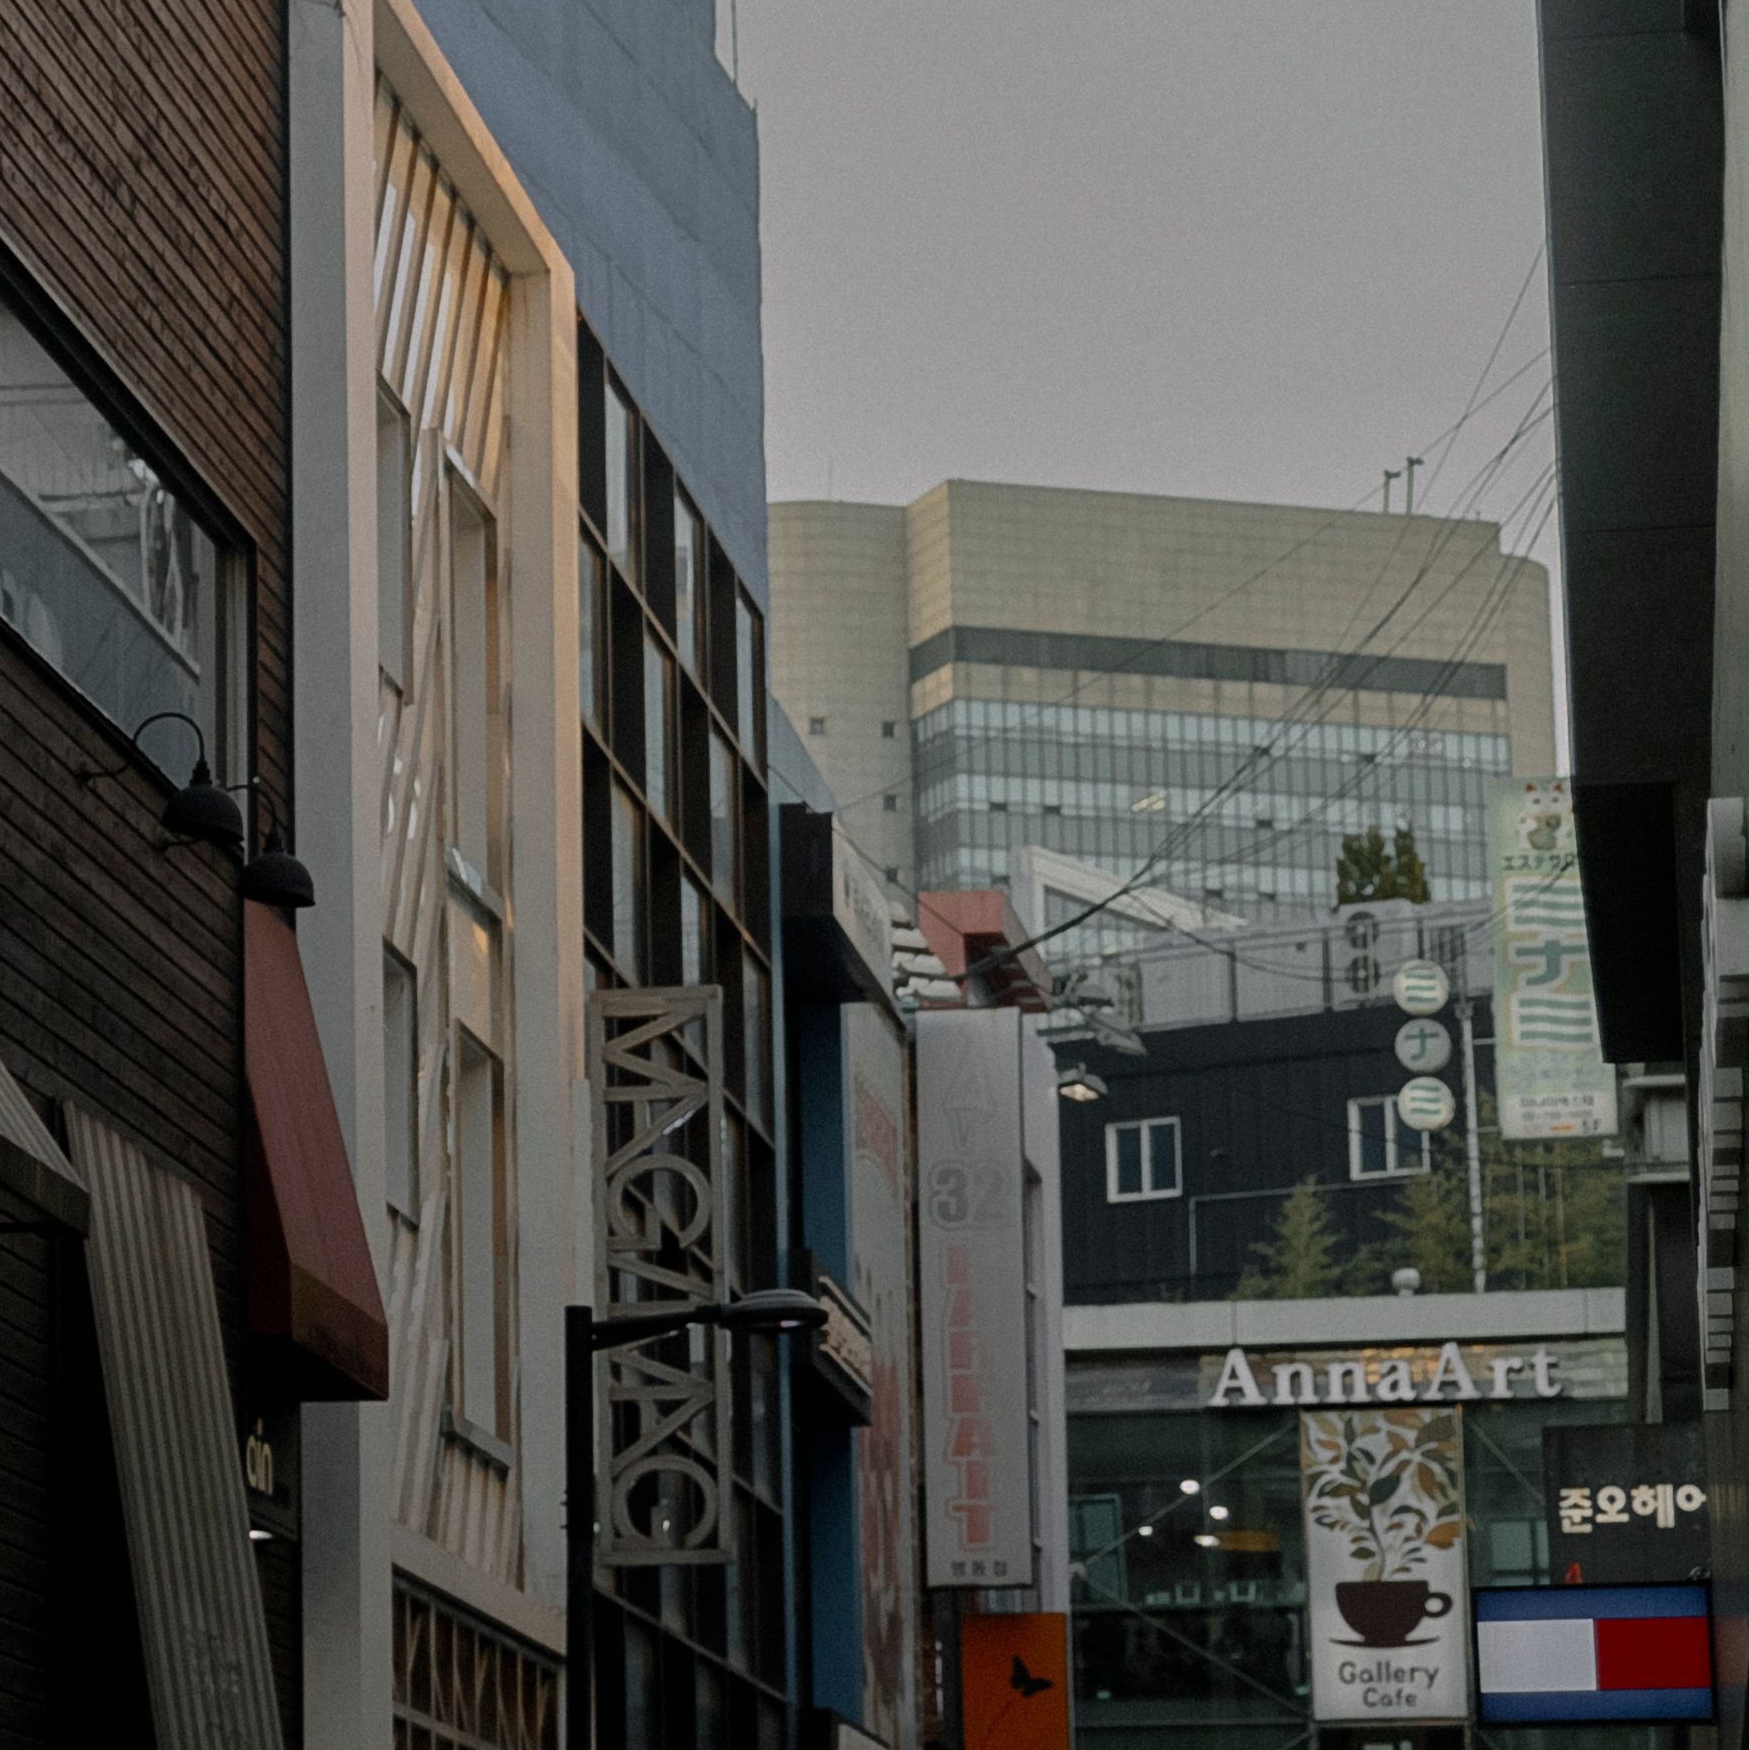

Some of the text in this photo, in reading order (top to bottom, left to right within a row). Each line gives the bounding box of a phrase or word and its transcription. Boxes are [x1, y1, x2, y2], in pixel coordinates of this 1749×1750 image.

[1403, 967, 1444, 1118] ミナミ
[1208, 1340, 1566, 1407] AnnaArt
[1339, 1660, 1440, 1689] Gallery
[1361, 1688, 1418, 1709] Cafe
